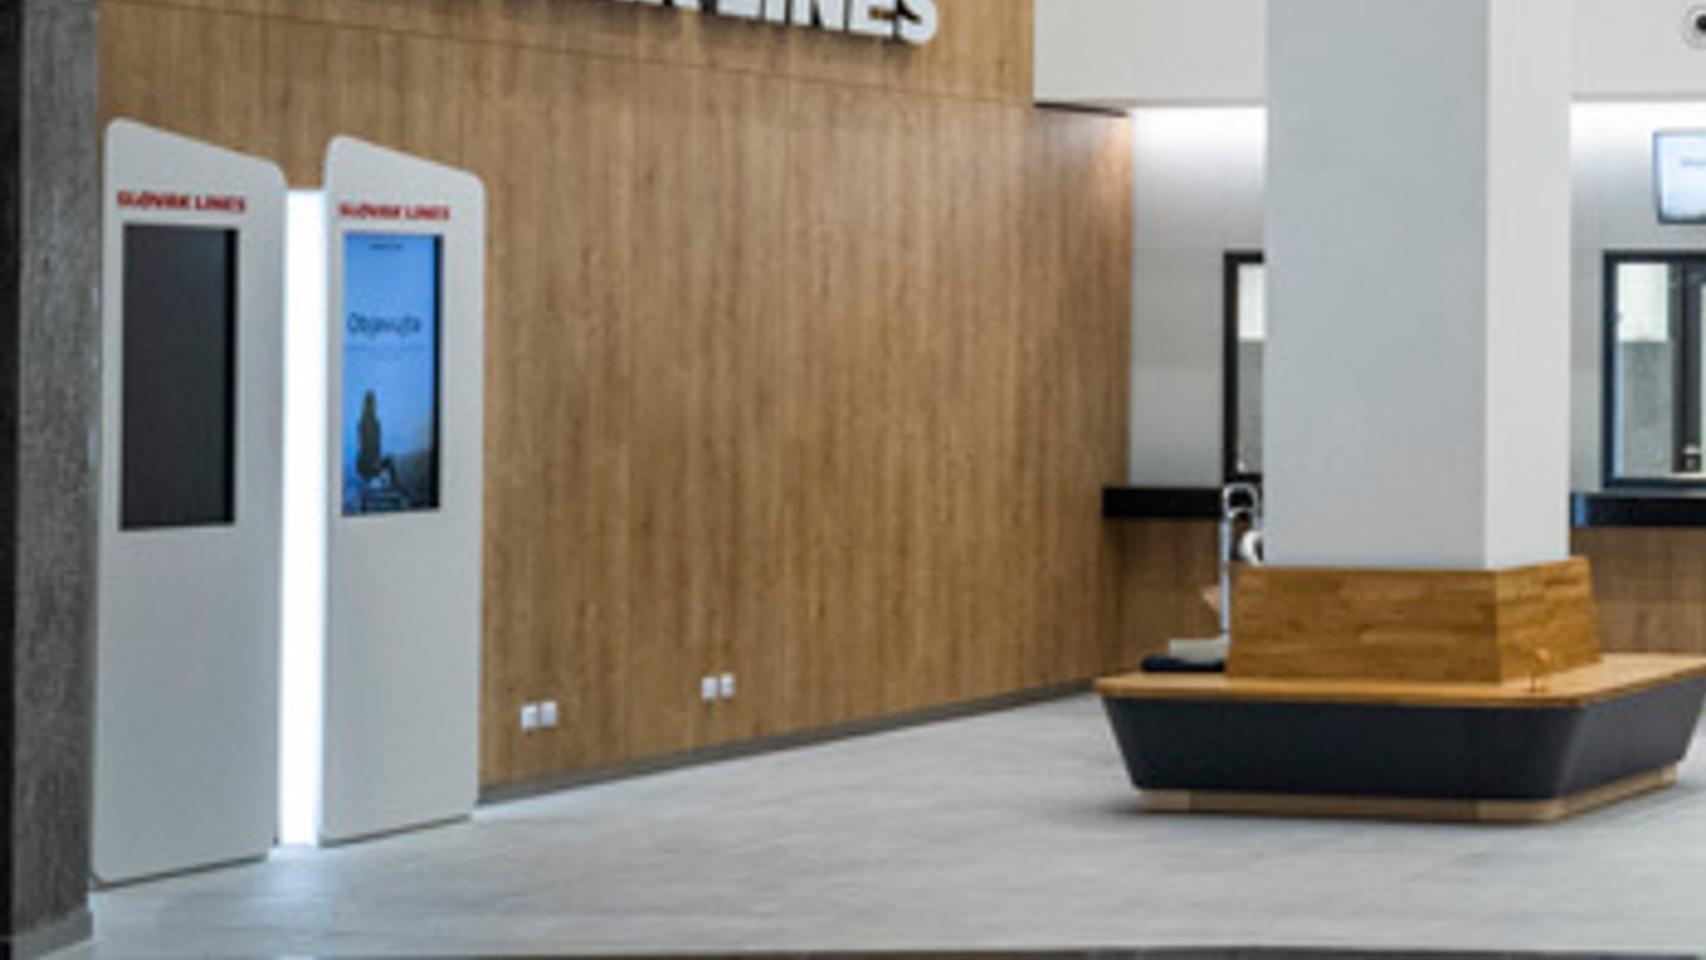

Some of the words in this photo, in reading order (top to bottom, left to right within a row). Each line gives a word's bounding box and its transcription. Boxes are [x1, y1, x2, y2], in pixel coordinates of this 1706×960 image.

[116, 189, 190, 211] SLOVAK
[195, 194, 246, 213] LINES
[338, 202, 400, 220] SLOVAK
[404, 204, 450, 221] LINES
